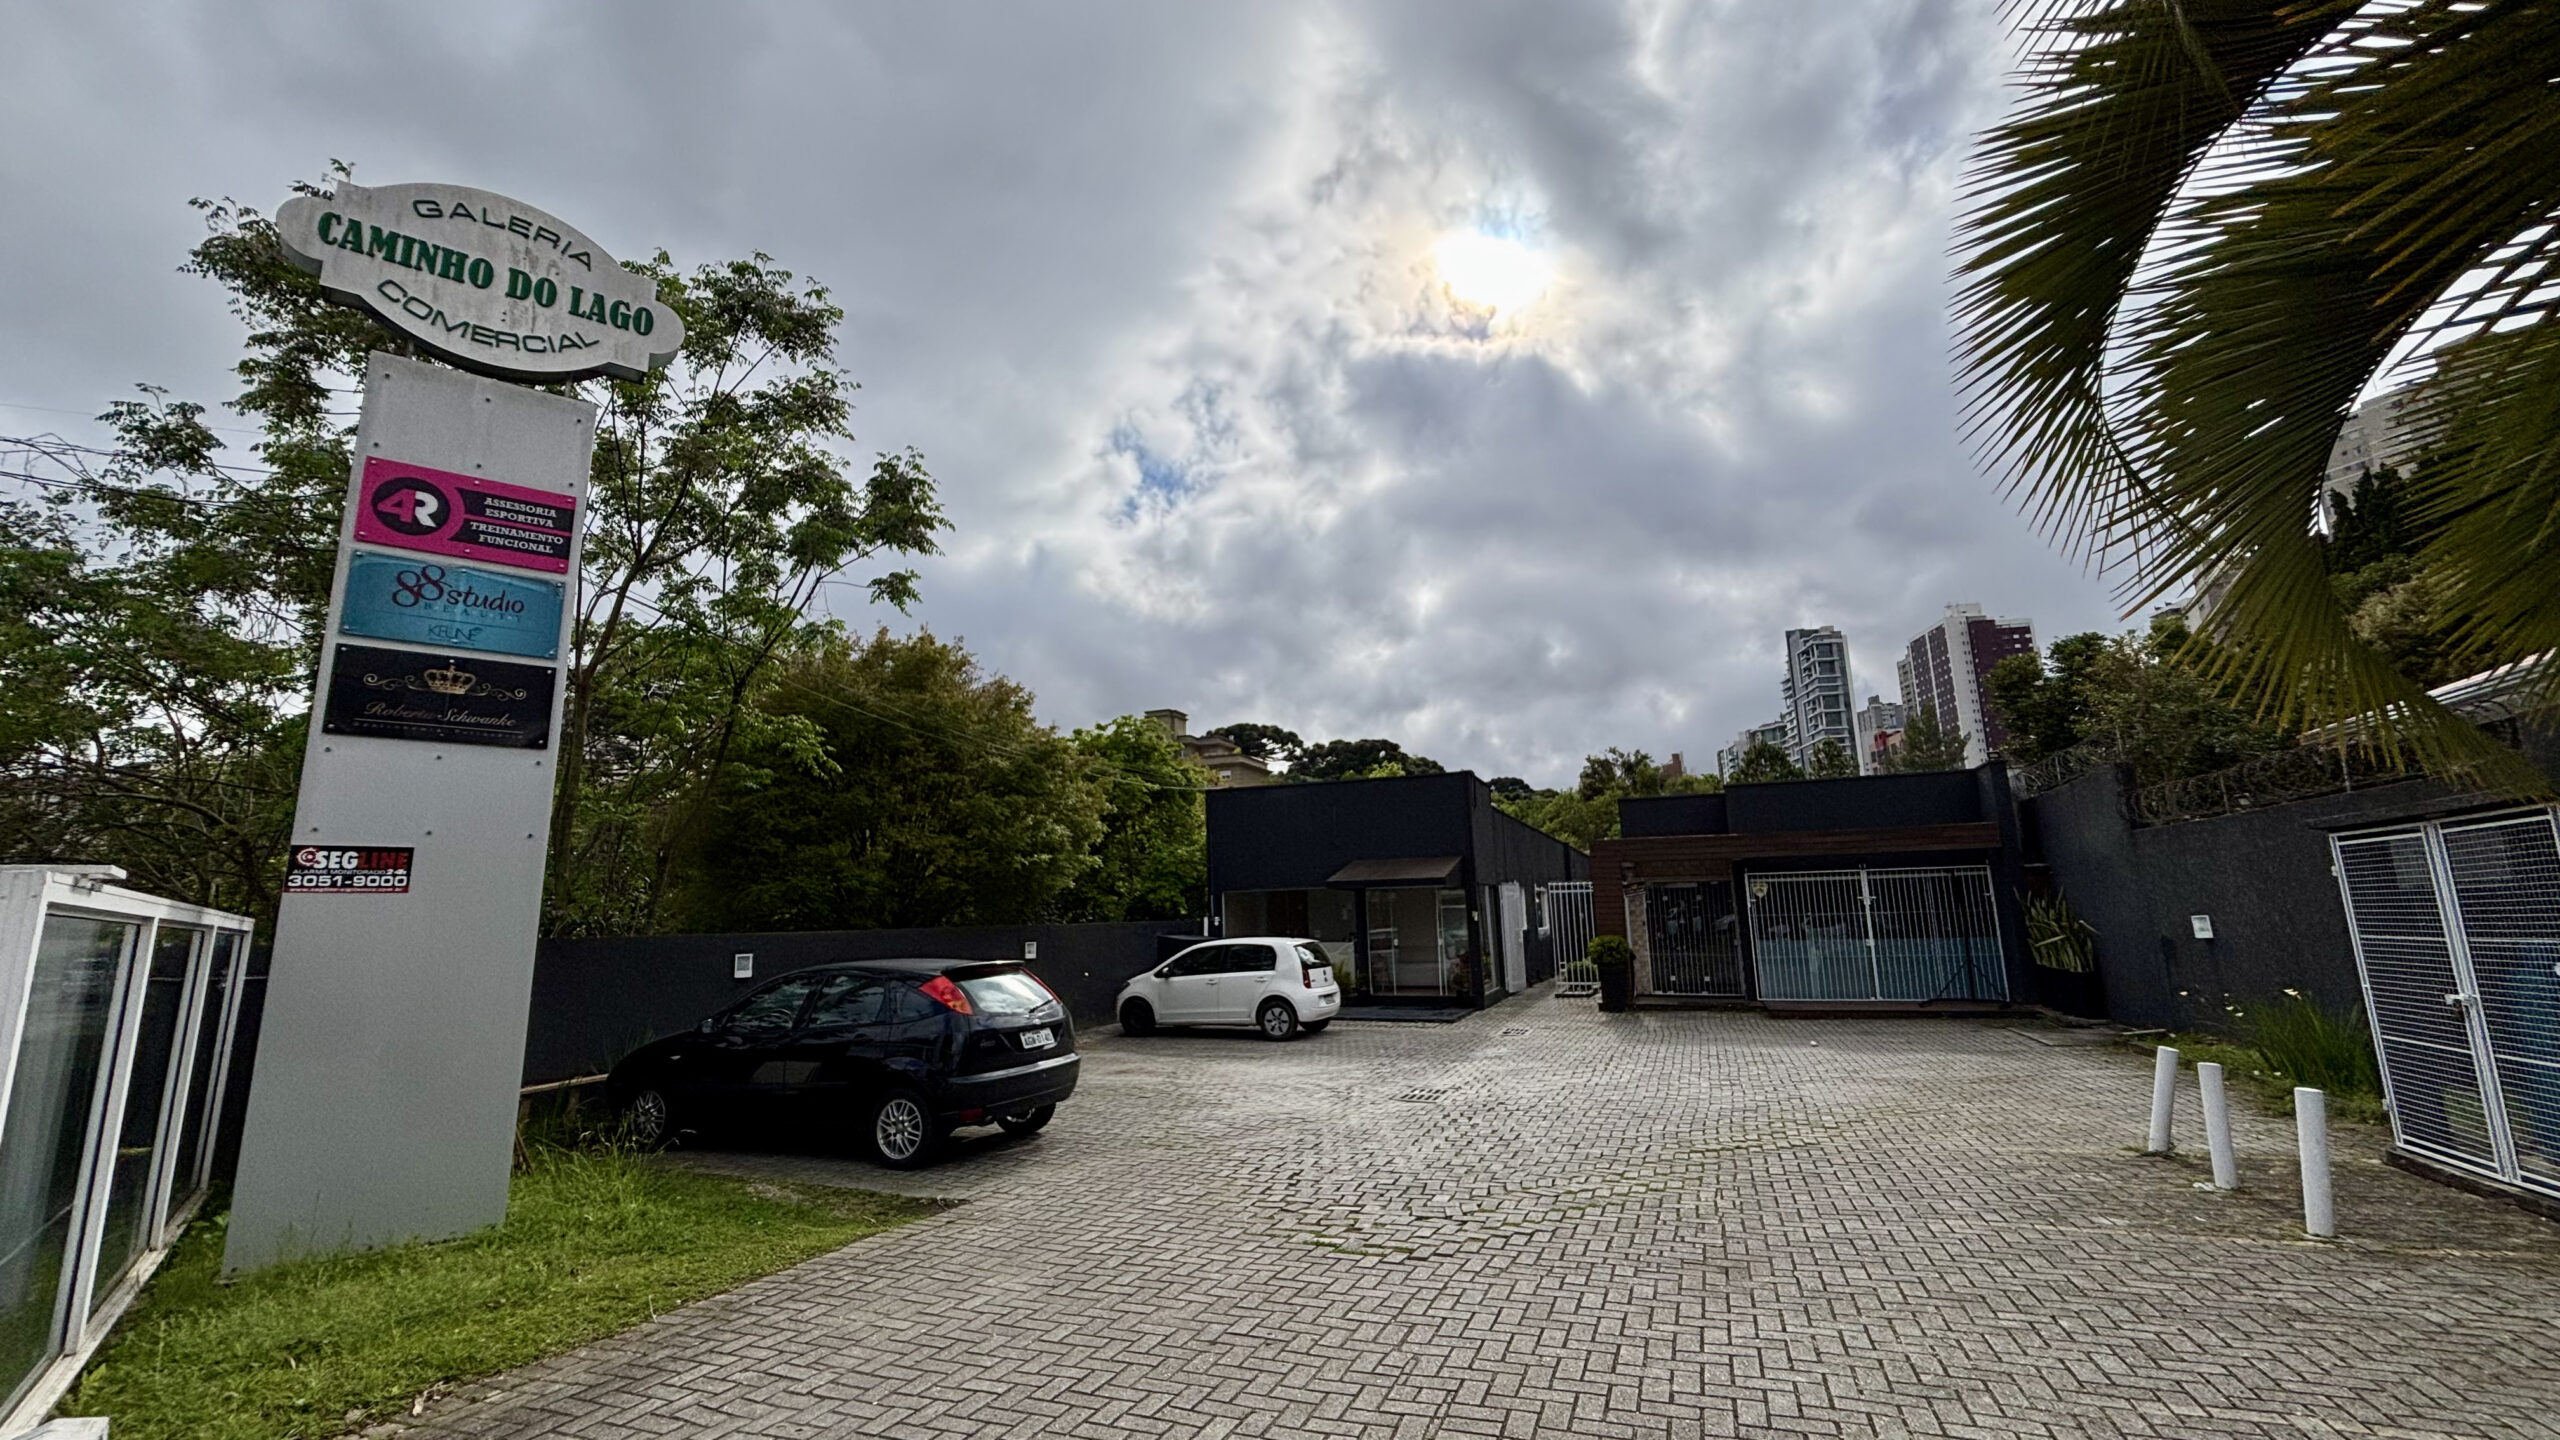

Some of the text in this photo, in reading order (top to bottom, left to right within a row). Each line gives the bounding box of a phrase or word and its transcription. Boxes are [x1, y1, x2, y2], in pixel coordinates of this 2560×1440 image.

[412, 199, 592, 272] GALERIA
[317, 210, 654, 337] CAMINHO DO LAGO
[377, 279, 600, 353] COMERCIAL
[377, 487, 439, 528] 4R
[484, 498, 556, 518] ASSESSORIA
[485, 509, 554, 528] ESPORTIVA
[471, 522, 563, 544] TREINAMENTO
[479, 534, 553, 553] FUNCIONAL
[447, 586, 524, 614] studio
[288, 875, 408, 887] 3051-9000
